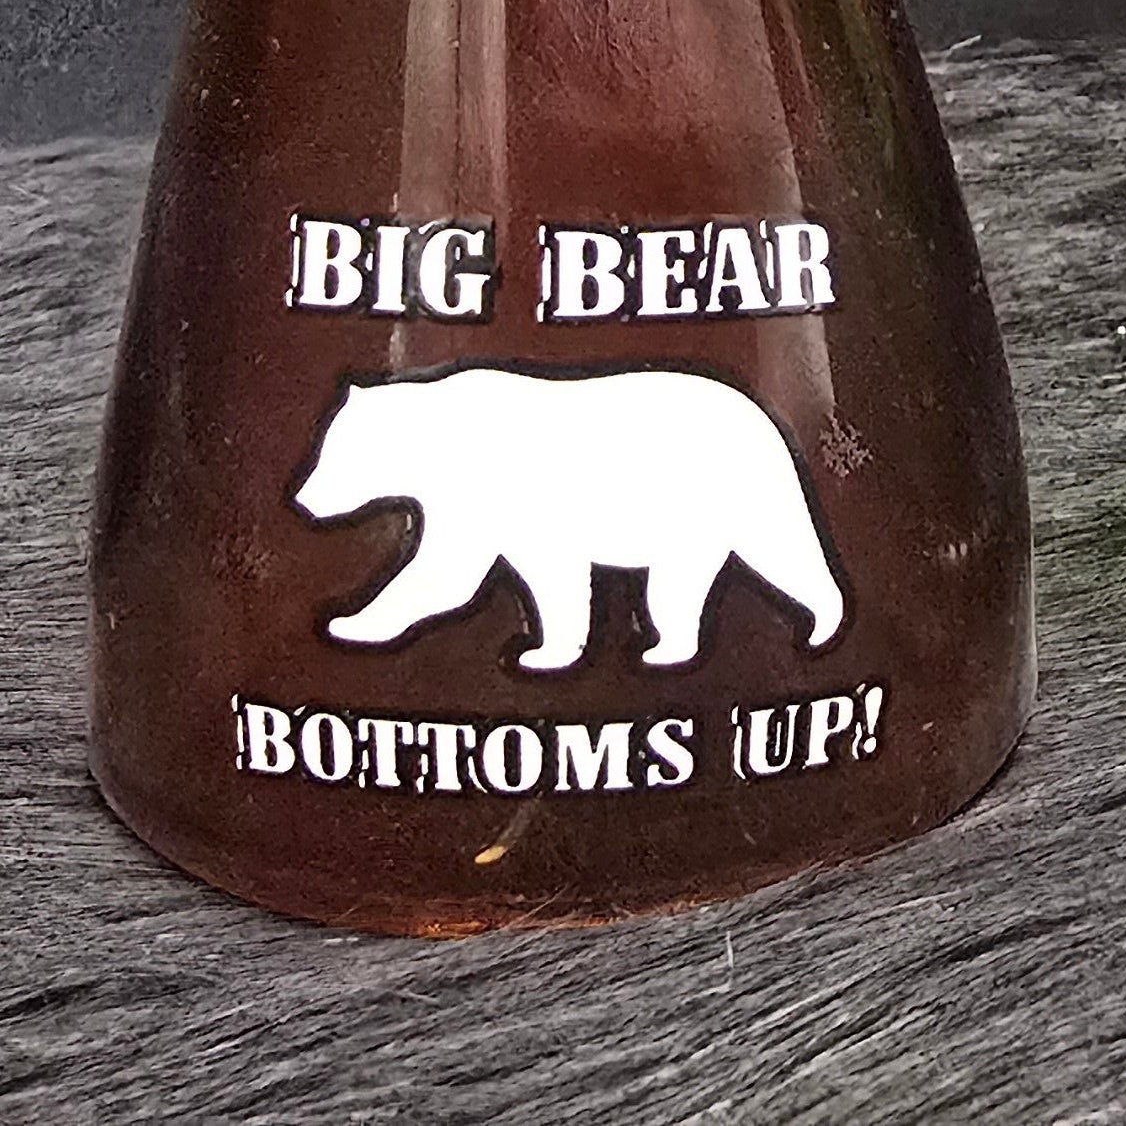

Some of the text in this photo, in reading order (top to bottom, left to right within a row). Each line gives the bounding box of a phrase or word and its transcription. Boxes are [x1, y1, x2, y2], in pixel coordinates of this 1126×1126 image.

[287, 214, 835, 320] BIG BEAR
[232, 685, 883, 793] BOTTOMS UP!
